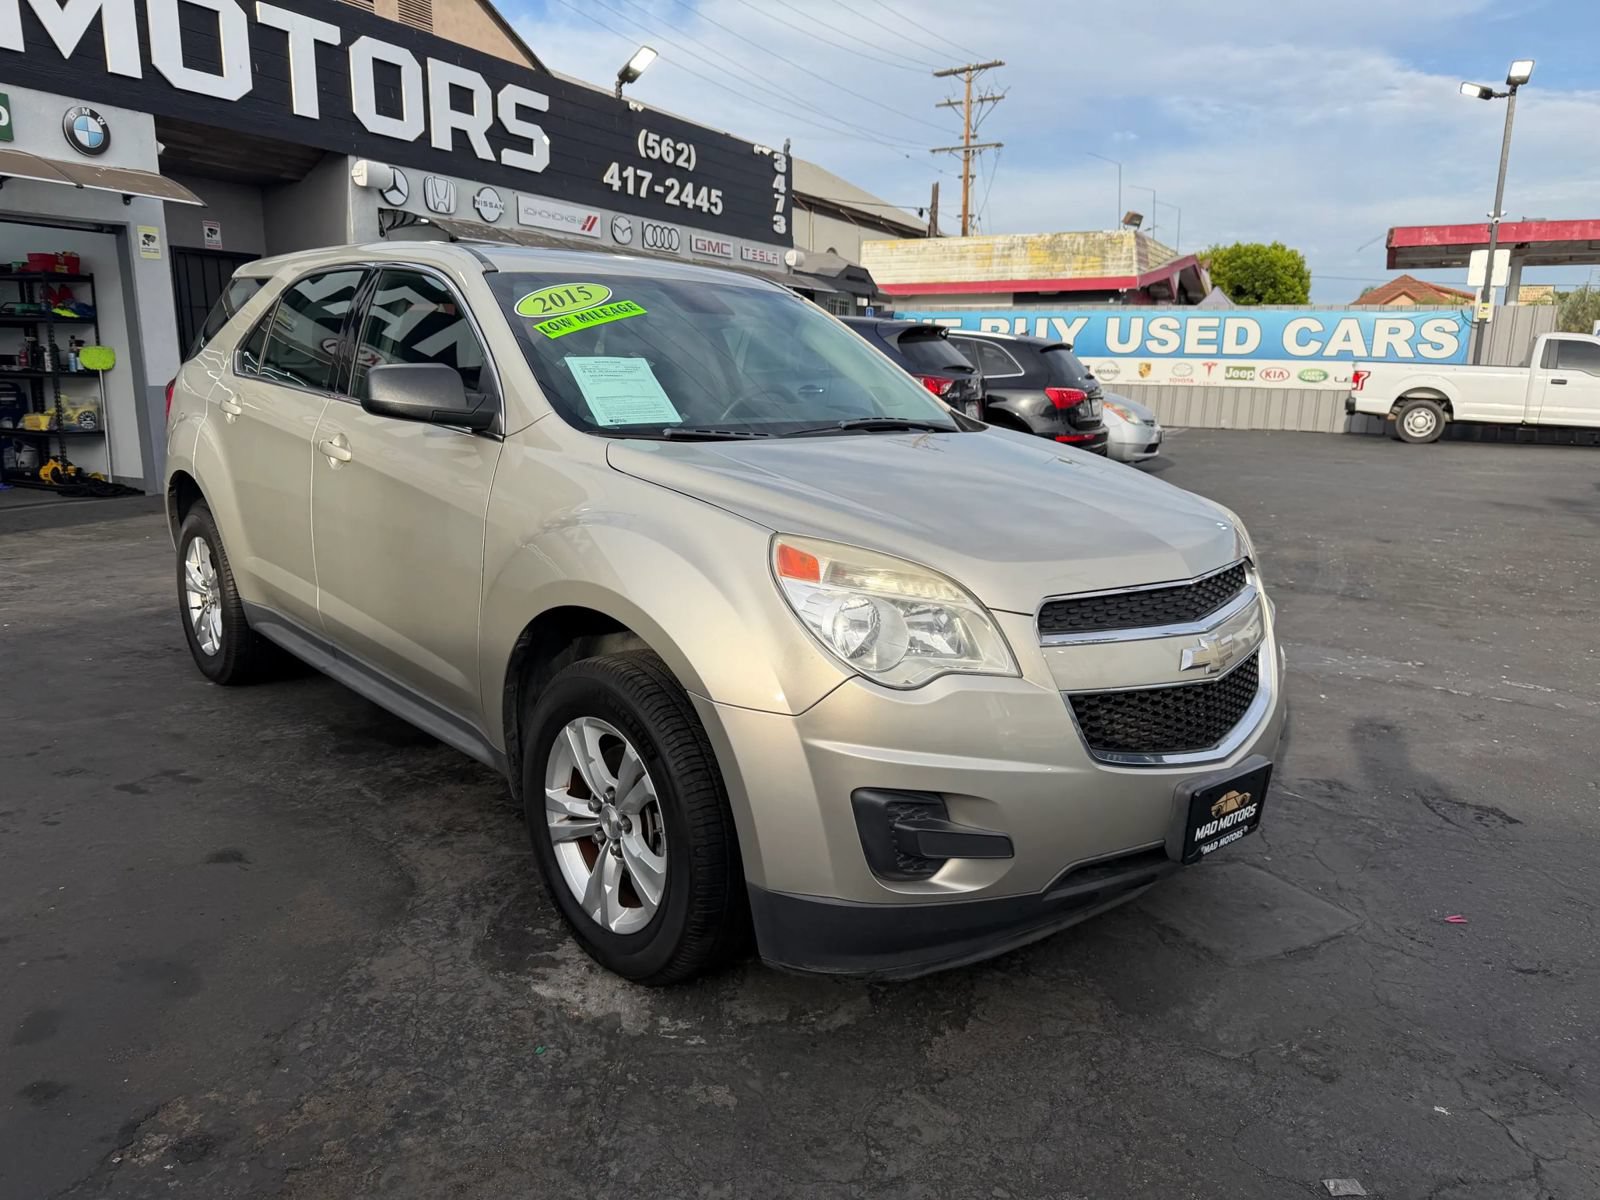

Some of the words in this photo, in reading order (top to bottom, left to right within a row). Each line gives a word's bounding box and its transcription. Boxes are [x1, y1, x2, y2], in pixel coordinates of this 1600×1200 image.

[0, 0, 551, 173] MOTORS
[70, 107, 106, 126] BMW
[638, 129, 696, 171] (562)
[603, 162, 723, 216] 417-2445
[475, 199, 505, 211] NISSAN
[695, 238, 731, 256] GMC
[744, 247, 778, 264] TESLA
[533, 286, 593, 313] 2015
[539, 317, 574, 334] LOW
[574, 302, 638, 324] MILEAGE
[1106, 316, 1261, 355] USED
[1282, 317, 1460, 359] CARS
[1225, 368, 1255, 380] Jeep
[1264, 371, 1285, 379] KIA
[1194, 819, 1219, 842] MAD
[1218, 802, 1258, 832] MOTORS
[1202, 841, 1219, 855] MAD
[1218, 829, 1244, 848] MOTORS
